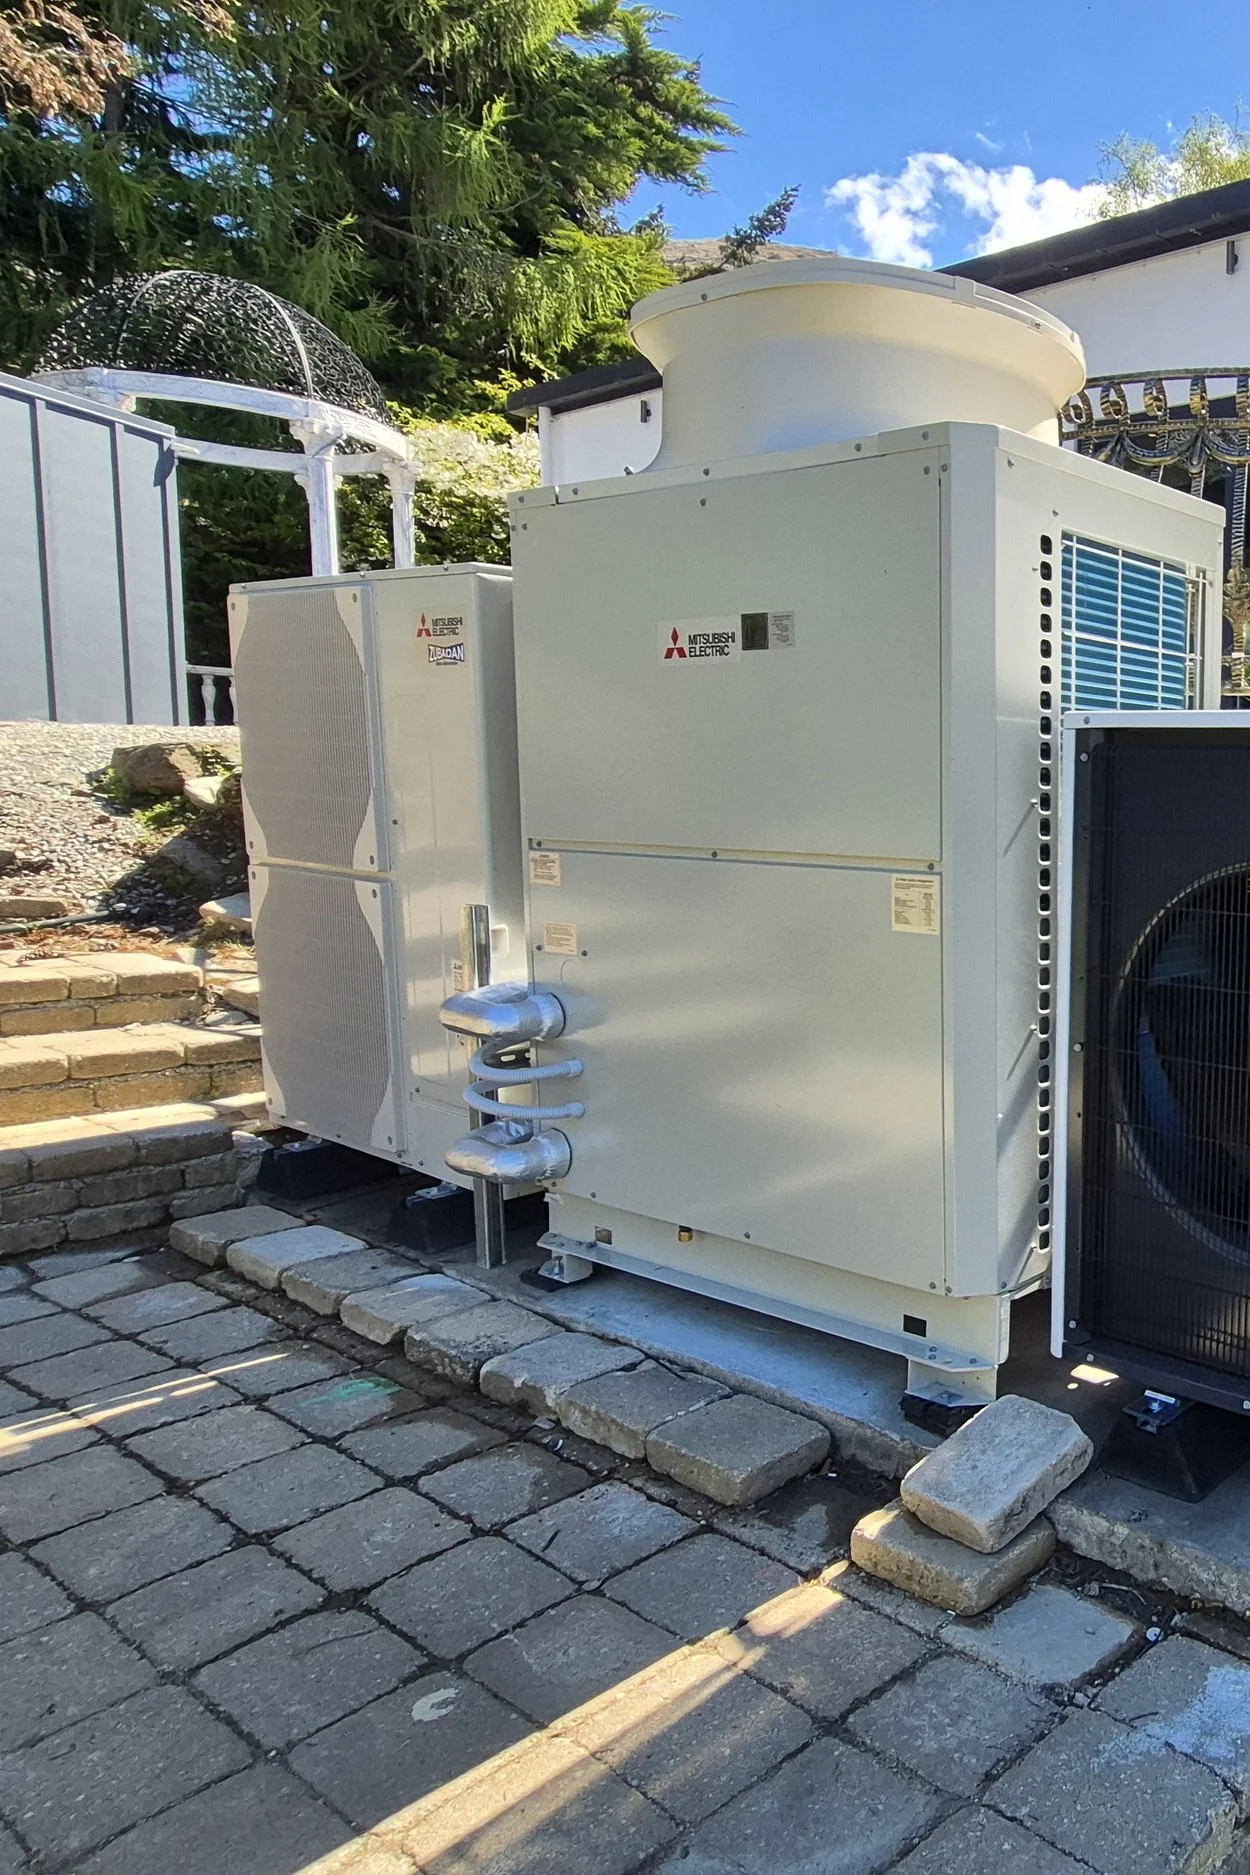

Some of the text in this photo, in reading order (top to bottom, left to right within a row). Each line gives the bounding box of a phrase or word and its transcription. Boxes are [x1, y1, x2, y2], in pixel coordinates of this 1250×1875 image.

[432, 617, 463, 627] MITSUBISHI
[432, 627, 459, 637] ELECTRIC
[688, 631, 736, 646] MITSUBISHI
[429, 645, 464, 661] ZUBADAN
[688, 644, 730, 658] ELECTRIC
